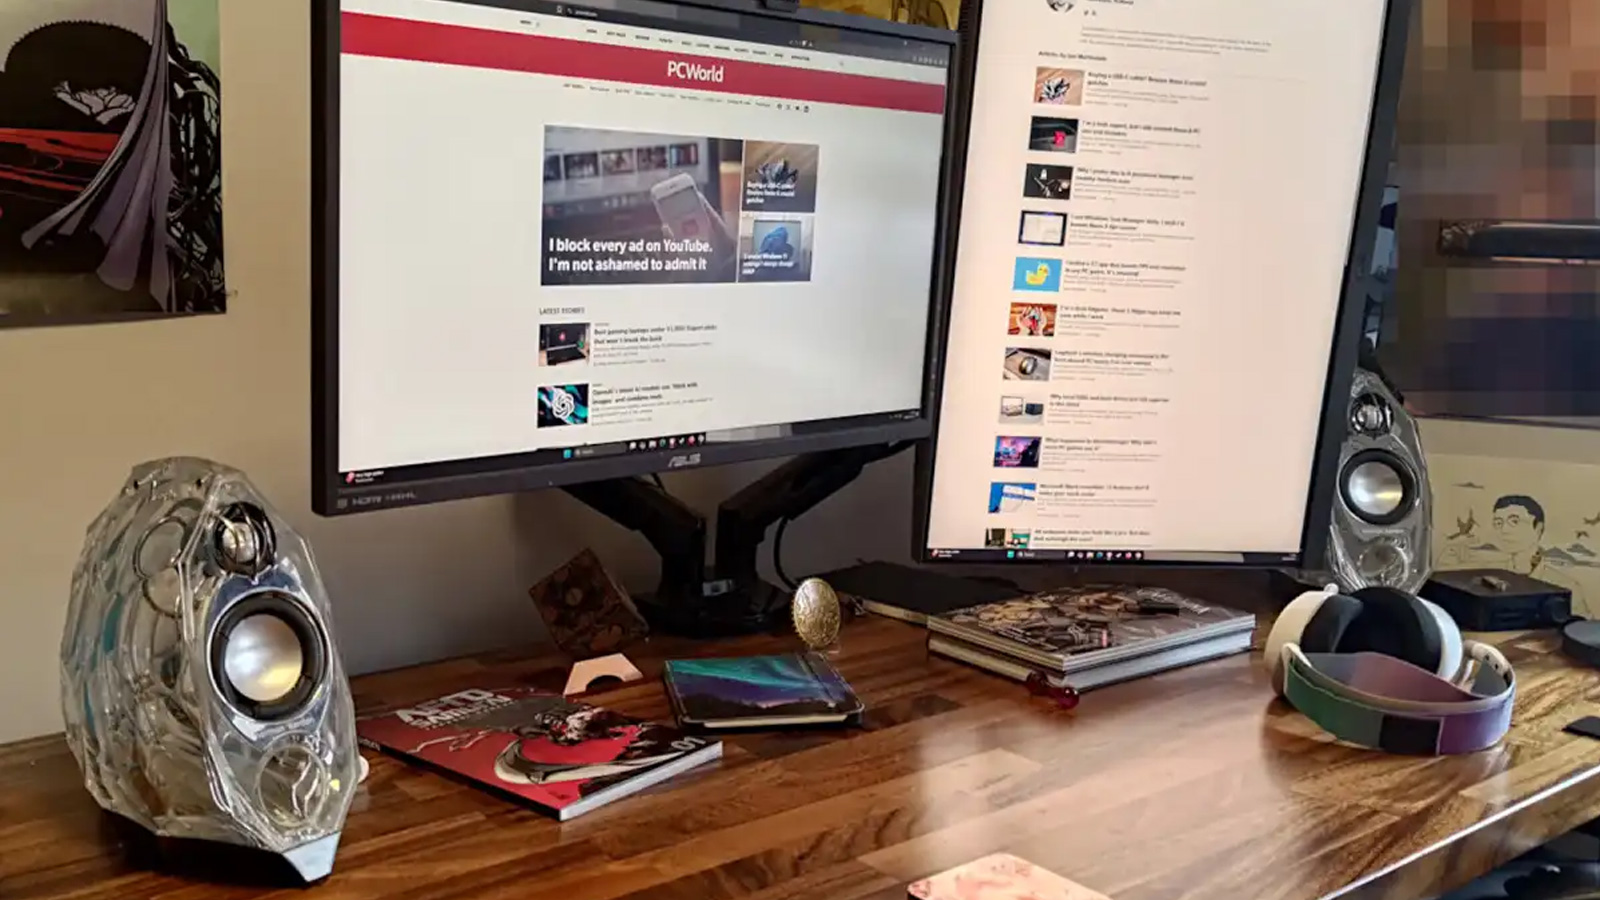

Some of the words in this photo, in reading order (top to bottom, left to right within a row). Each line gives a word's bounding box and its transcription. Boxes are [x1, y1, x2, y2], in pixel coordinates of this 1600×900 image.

[667, 60, 724, 84] PCWorld
[549, 238, 554, 252] I
[556, 238, 591, 252] block
[593, 240, 627, 255] every
[628, 239, 643, 252] ad
[646, 240, 661, 252] on
[663, 239, 713, 252] YouTube.
[549, 258, 570, 271] I'm
[572, 258, 593, 271] not
[595, 258, 648, 271] ashamed
[650, 258, 663, 271] to
[665, 258, 697, 271] admit
[699, 258, 707, 271] it
[668, 453, 701, 468] ASUS
[670, 736, 708, 753] 01
